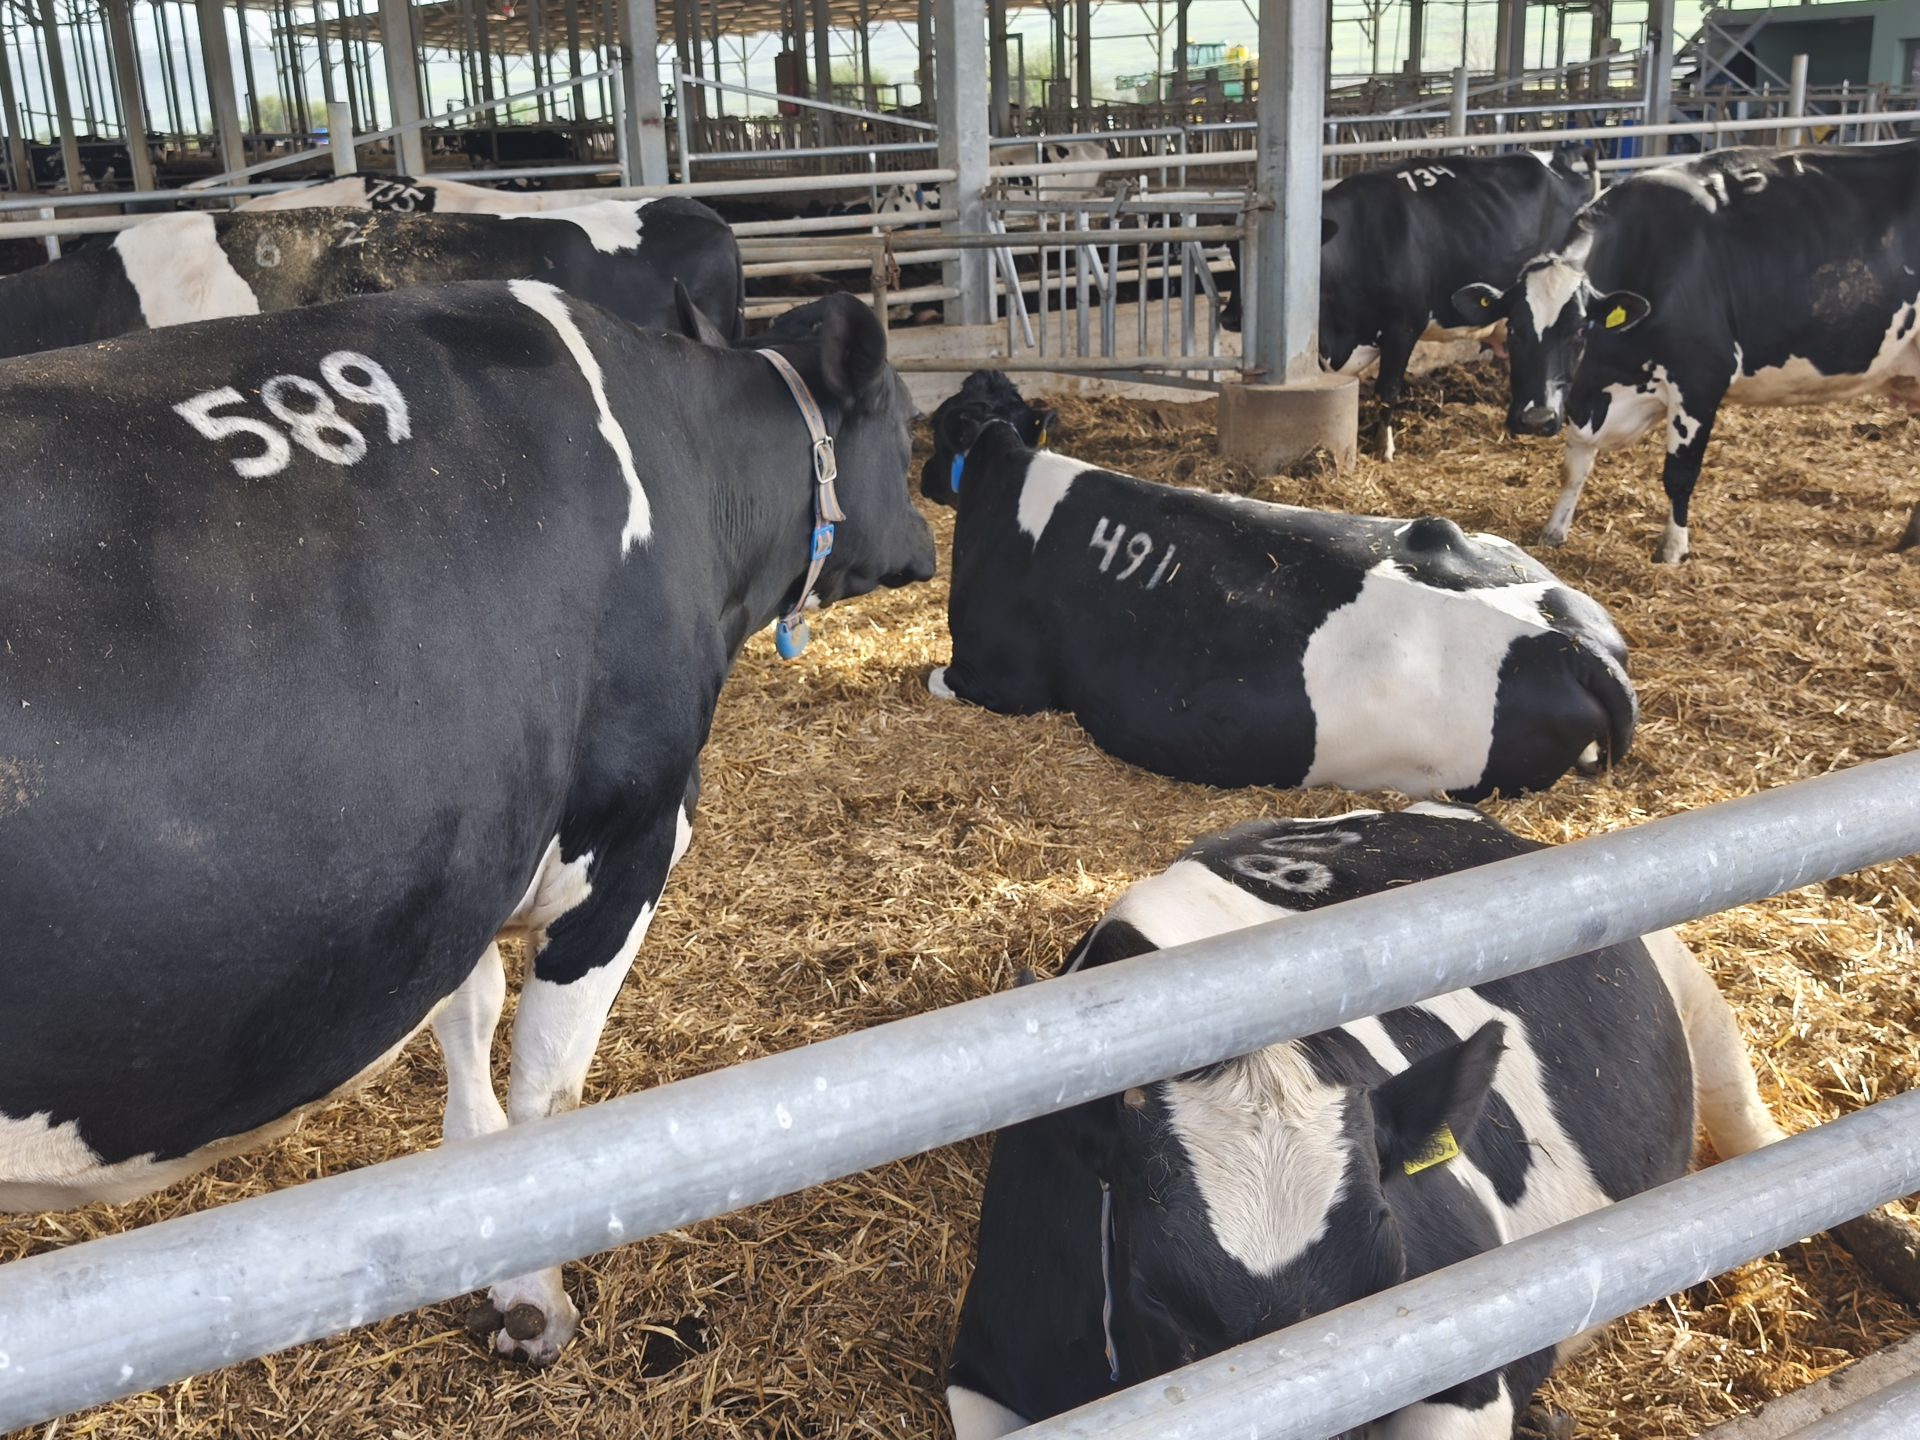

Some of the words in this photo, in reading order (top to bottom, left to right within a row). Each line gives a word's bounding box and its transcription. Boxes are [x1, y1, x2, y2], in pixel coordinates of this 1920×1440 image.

[366, 178, 426, 213] 735
[1396, 165, 1456, 192] 734
[172, 350, 413, 478] 589
[1089, 515, 1176, 590] 491
